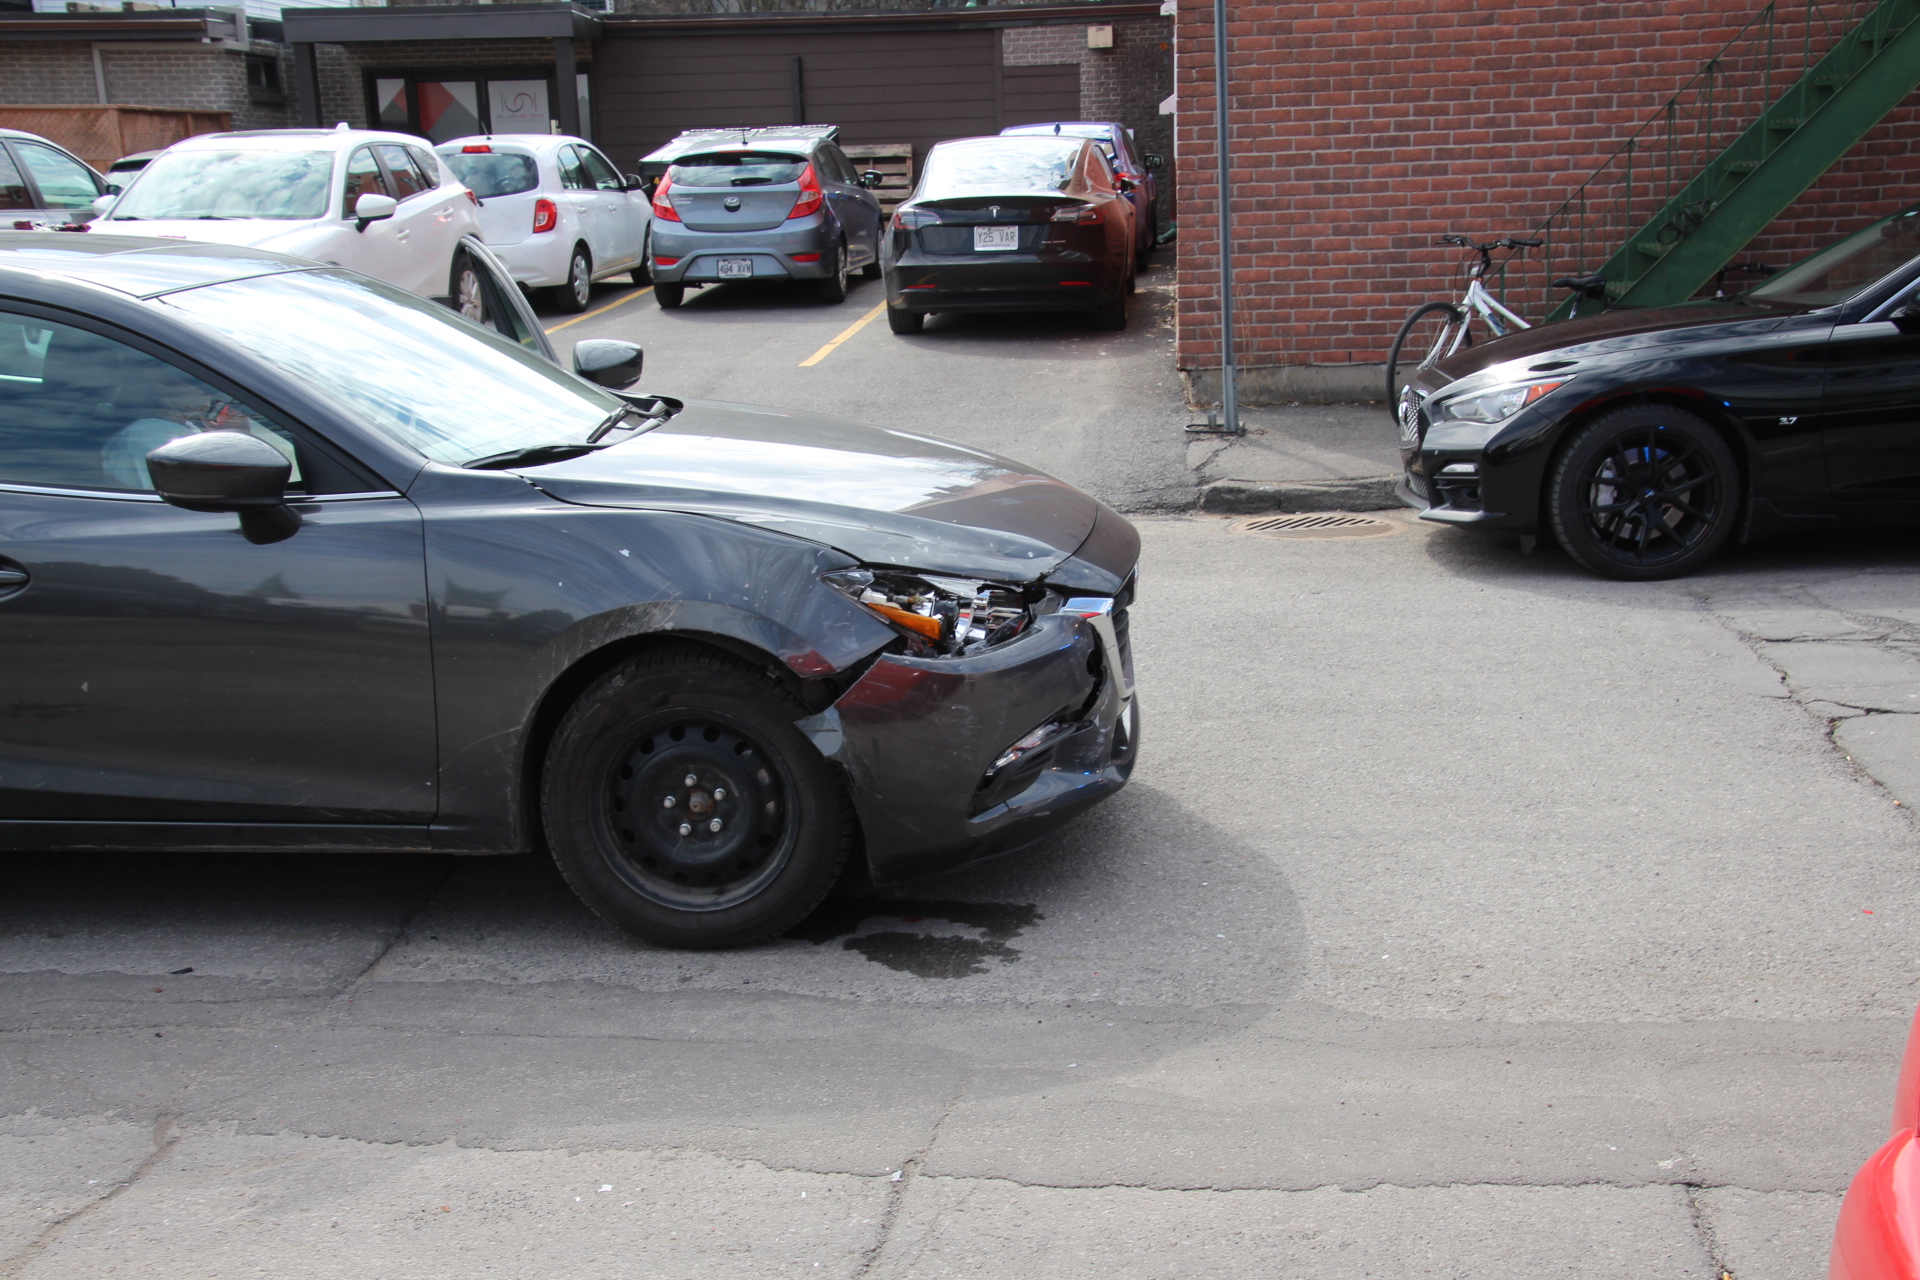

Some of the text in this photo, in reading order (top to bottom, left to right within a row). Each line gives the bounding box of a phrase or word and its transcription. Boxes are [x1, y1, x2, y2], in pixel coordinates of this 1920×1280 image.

[977, 231, 1016, 243] Y25 VAR
[737, 263, 751, 273] XVN
